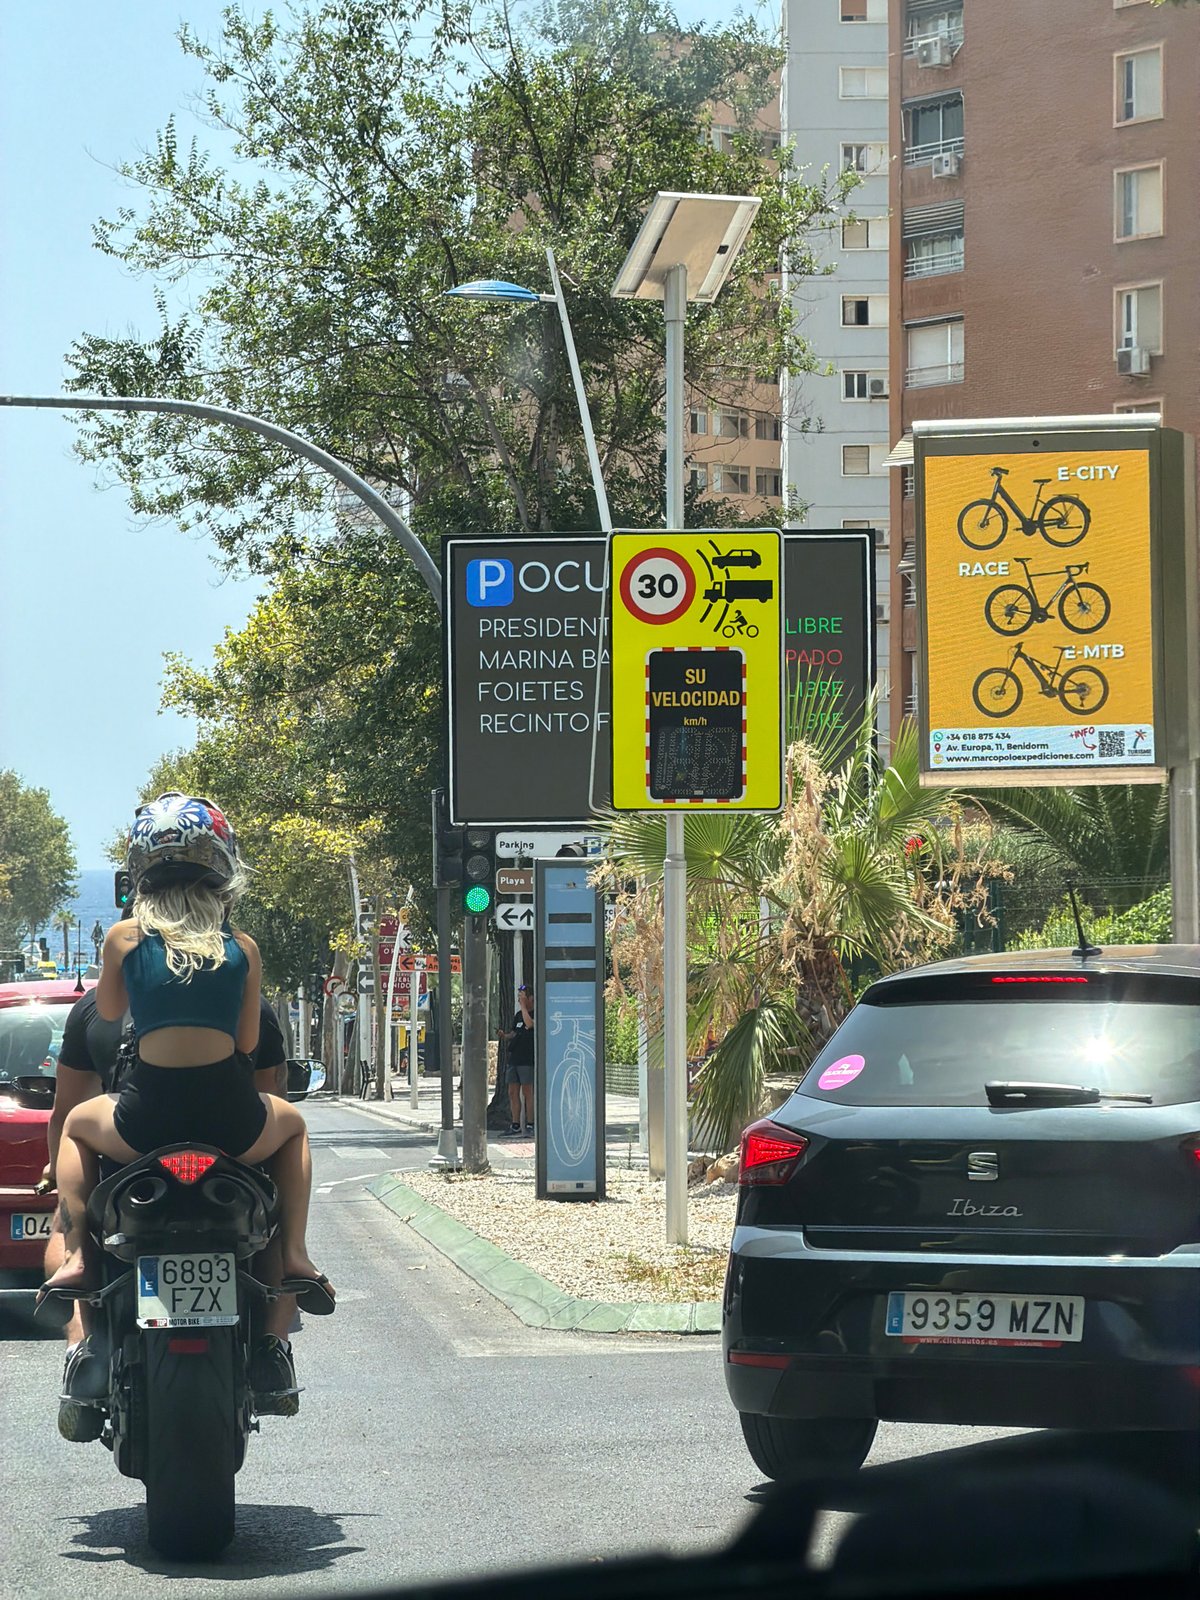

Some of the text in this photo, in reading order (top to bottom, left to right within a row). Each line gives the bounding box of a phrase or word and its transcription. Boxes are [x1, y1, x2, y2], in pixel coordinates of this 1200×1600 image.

[1056, 465, 1120, 481] E-CITY
[958, 561, 1010, 577] RACE
[479, 560, 506, 600] P
[637, 573, 679, 600] 30
[785, 617, 843, 634] LIBRE
[479, 649, 575, 670] MARINA
[1063, 644, 1125, 660] E-MTB
[685, 668, 706, 685] SU
[478, 680, 584, 702] FOIETES
[652, 690, 741, 708] VELOCIDAD
[480, 712, 590, 733] RECINTO
[683, 716, 708, 727] km/h
[945, 732, 1011, 741] +34 618 875 434
[1069, 726, 1095, 739] +INFO
[946, 741, 1049, 753] Av. Europa, 11, Benidorm
[946, 751, 1095, 763] www.marcopoloexpediciones.com
[499, 841, 535, 850] Parking
[500, 876, 525, 886] Playa
[946, 1198, 1024, 1217] Ibiza
[25, 1216, 51, 1236] 04
[145, 1258, 230, 1291] E 6893
[171, 1286, 222, 1313] FZX
[188, 1317, 200, 1325] BIKE
[892, 1297, 1074, 1335] E 9359 MZN
